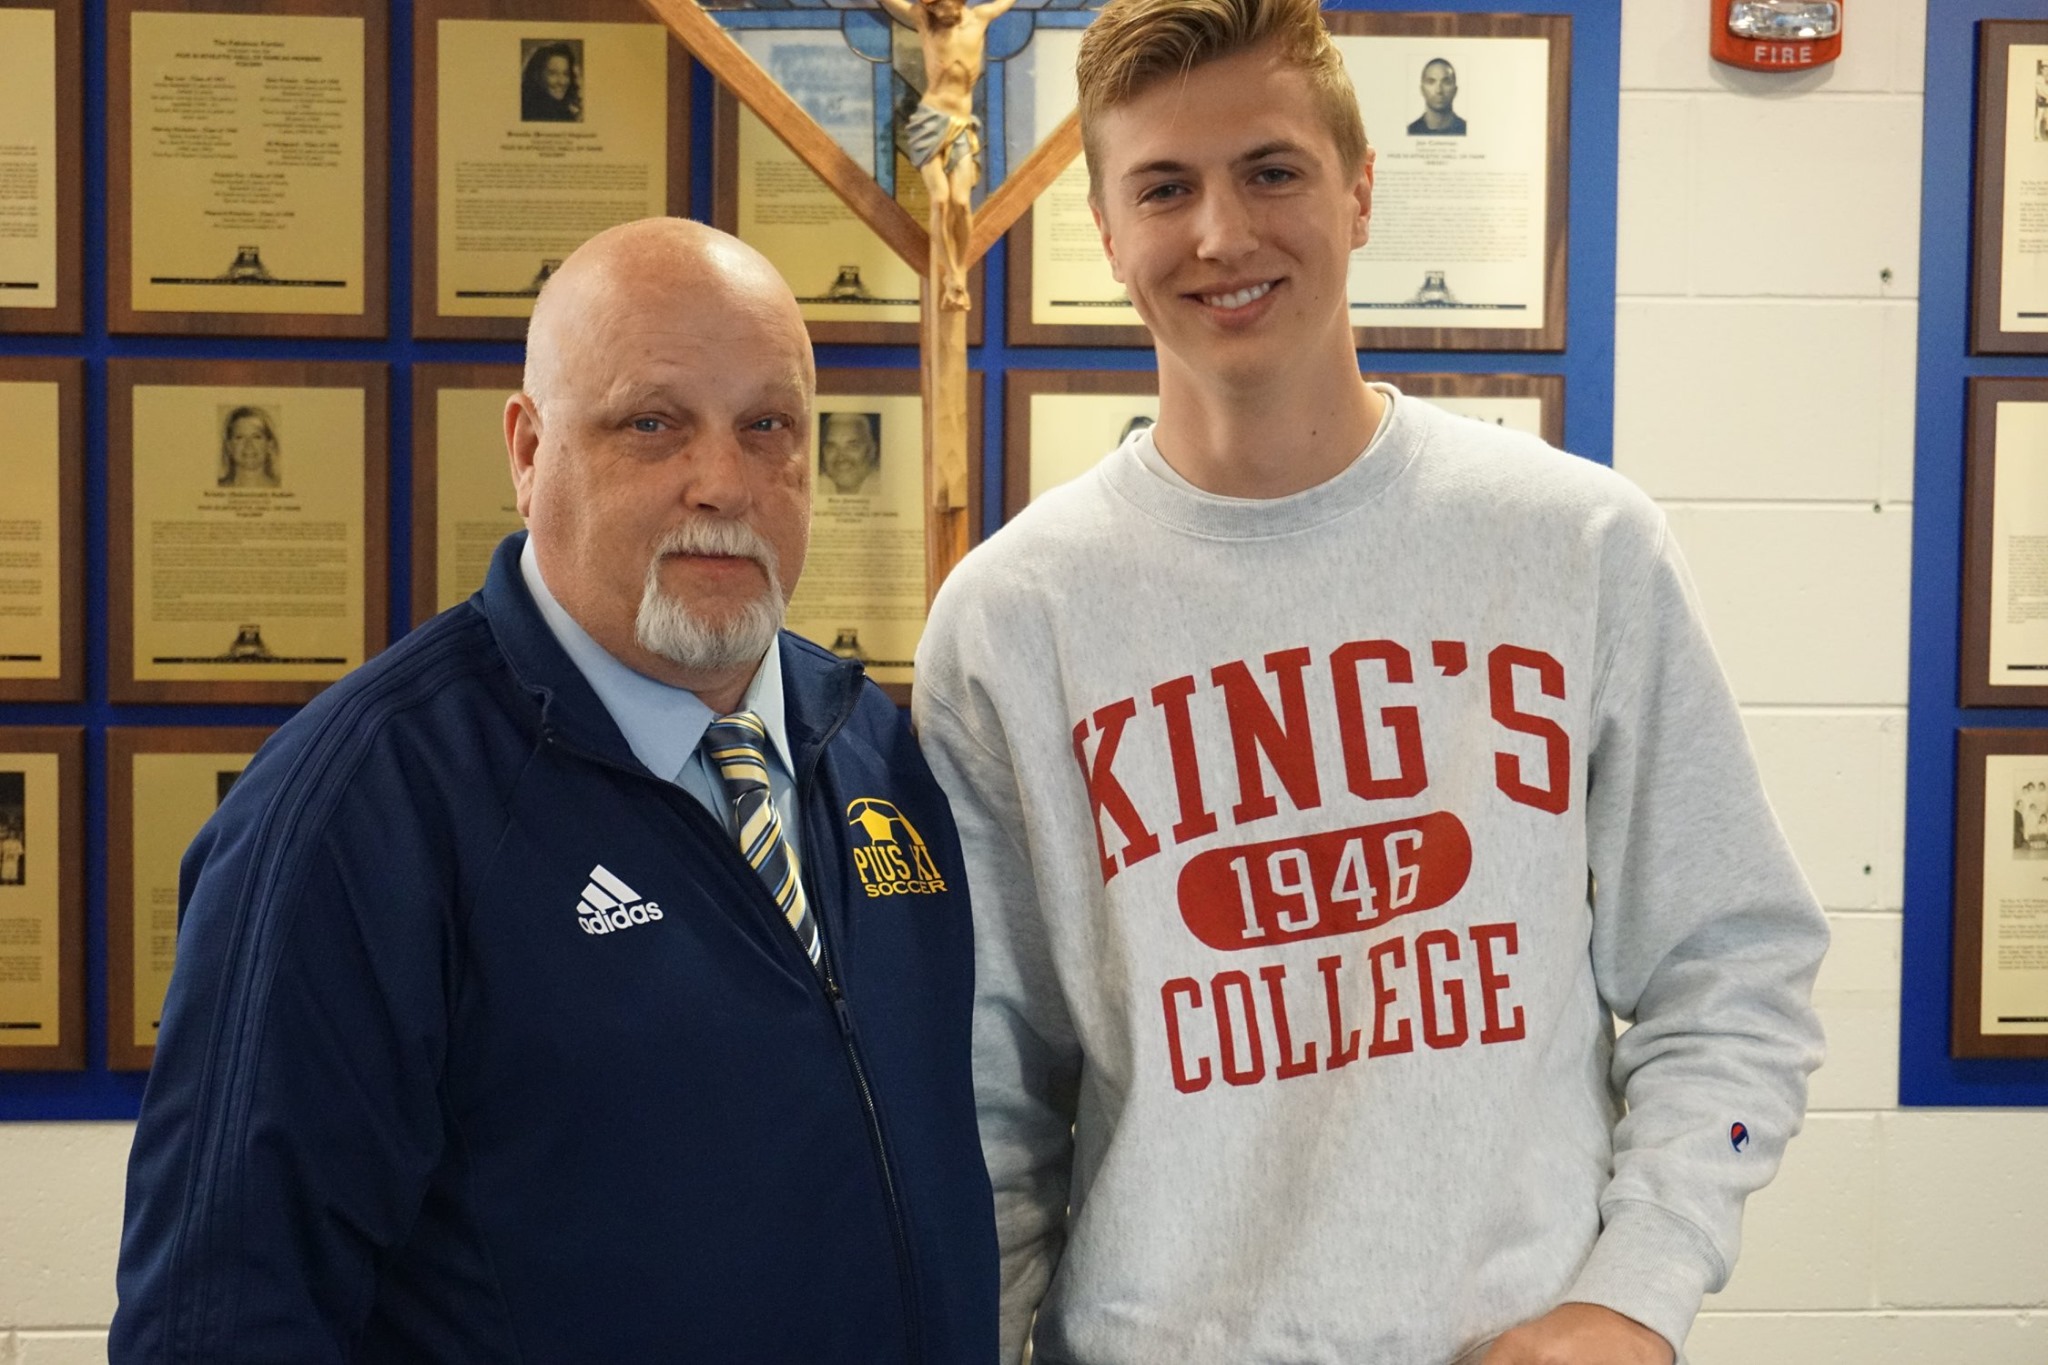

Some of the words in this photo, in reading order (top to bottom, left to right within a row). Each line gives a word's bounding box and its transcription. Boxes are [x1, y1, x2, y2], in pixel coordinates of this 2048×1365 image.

[1753, 45, 1813, 64] FIRE
[1073, 639, 1571, 887] KING'S
[853, 845, 911, 884] PIUS
[908, 844, 941, 881] XI
[864, 880, 948, 898] SOCCER
[1227, 828, 1425, 941] 1946
[578, 902, 664, 935] adidas
[1161, 922, 1526, 1094] COLLEGE
